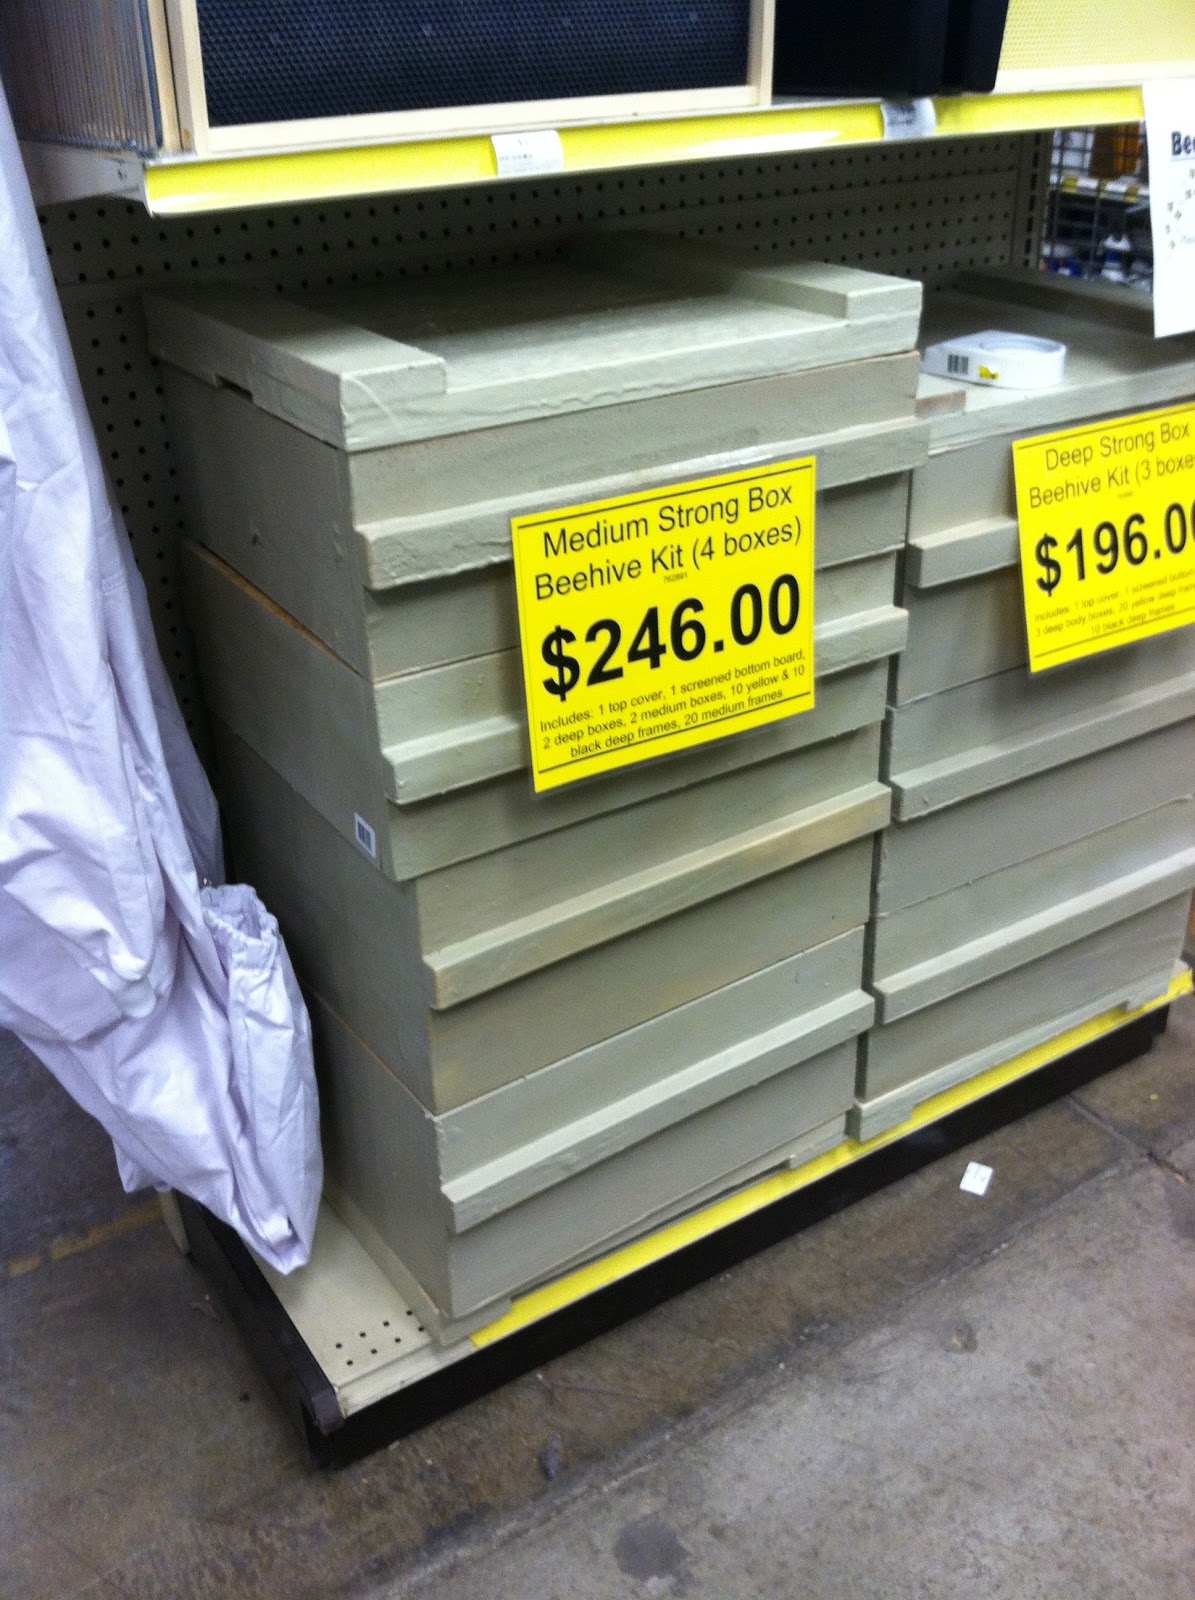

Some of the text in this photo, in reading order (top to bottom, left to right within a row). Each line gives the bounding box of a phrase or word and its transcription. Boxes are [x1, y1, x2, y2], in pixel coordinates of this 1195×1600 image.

[1171, 131, 1195, 156] Be
[1029, 453, 1195, 509] Beehive Kit (3 boxe
[1045, 422, 1190, 471] Deep Strong Box
[543, 485, 793, 558] Medium Strong Box
[1034, 496, 1195, 598] $196.0
[534, 516, 802, 601] Beehive Kit (4 boxes)
[541, 573, 800, 703] $246.00
[1043, 622, 1064, 636] deep
[1065, 615, 1086, 629] body
[1103, 617, 1124, 632] black
[540, 709, 593, 733] Includes:
[598, 704, 605, 716] 1
[608, 700, 628, 713] top
[670, 685, 676, 696] 1
[680, 671, 732, 693] screened
[734, 660, 770, 679] bottom
[773, 649, 806, 668] board,
[543, 737, 551, 750] 2
[554, 727, 584, 747] deep
[629, 712, 637, 723] 2
[640, 699, 687, 721] medium
[731, 683, 743, 696] 10
[746, 672, 779, 693] yellow
[782, 669, 790, 681] &
[793, 664, 805, 677] 10
[570, 688, 783, 758] black deep frames, 20 medium frames
